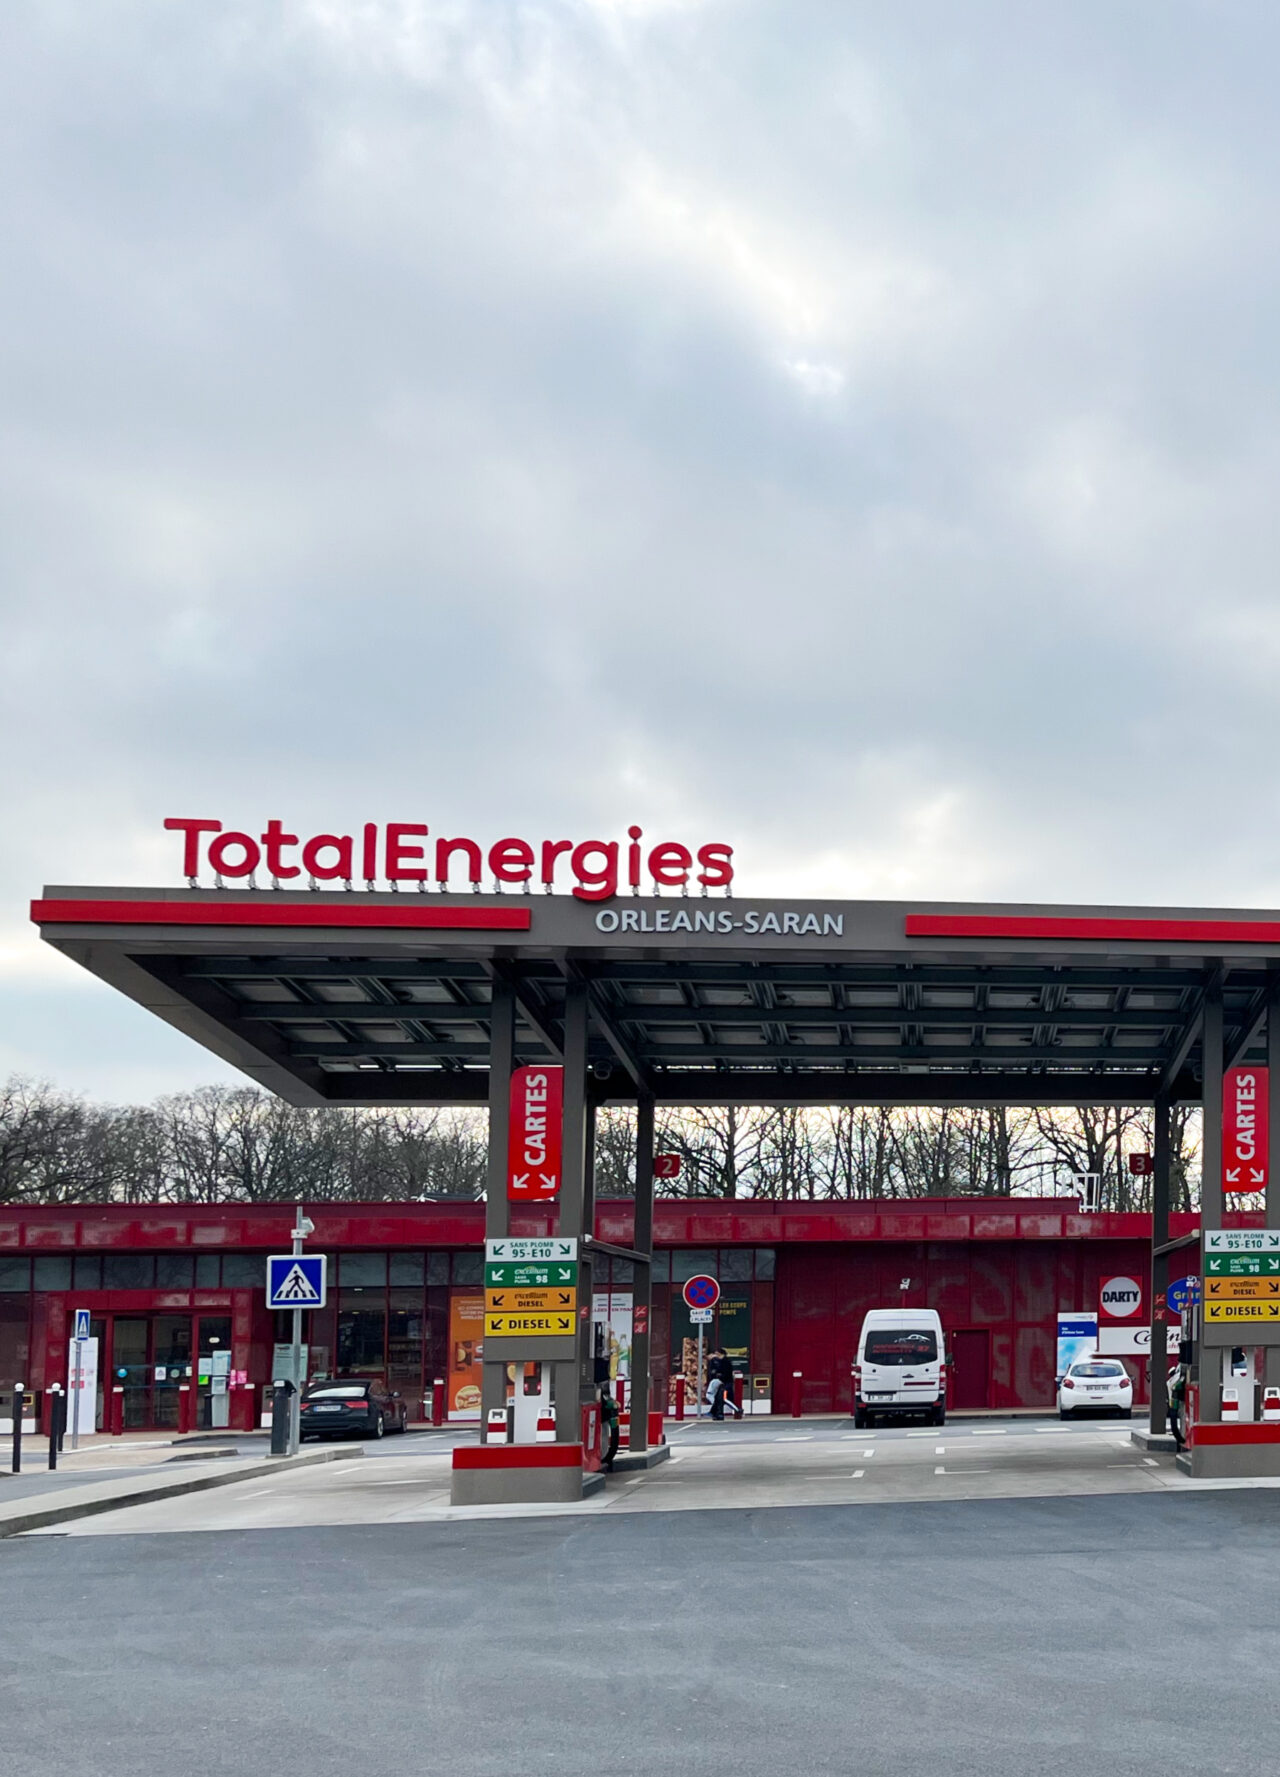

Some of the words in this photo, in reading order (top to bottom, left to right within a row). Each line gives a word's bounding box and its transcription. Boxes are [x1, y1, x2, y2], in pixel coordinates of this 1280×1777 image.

[164, 817, 734, 900] TotalEnergies
[595, 908, 844, 936] ORLEANS-SARAN
[524, 1074, 547, 1166] CARTES
[1236, 1074, 1256, 1160] CARTES
[662, 1159, 673, 1174] 2
[1135, 1156, 1145, 1172] 3
[1227, 1240, 1262, 1249] 95-E10
[512, 1248, 551, 1258] 95-E10
[1249, 1265, 1260, 1273] 98
[535, 1275, 548, 1284] 98
[1102, 1290, 1139, 1303] DARTY
[1225, 1306, 1263, 1315] DIESEL
[508, 1319, 551, 1329] DIESEL
